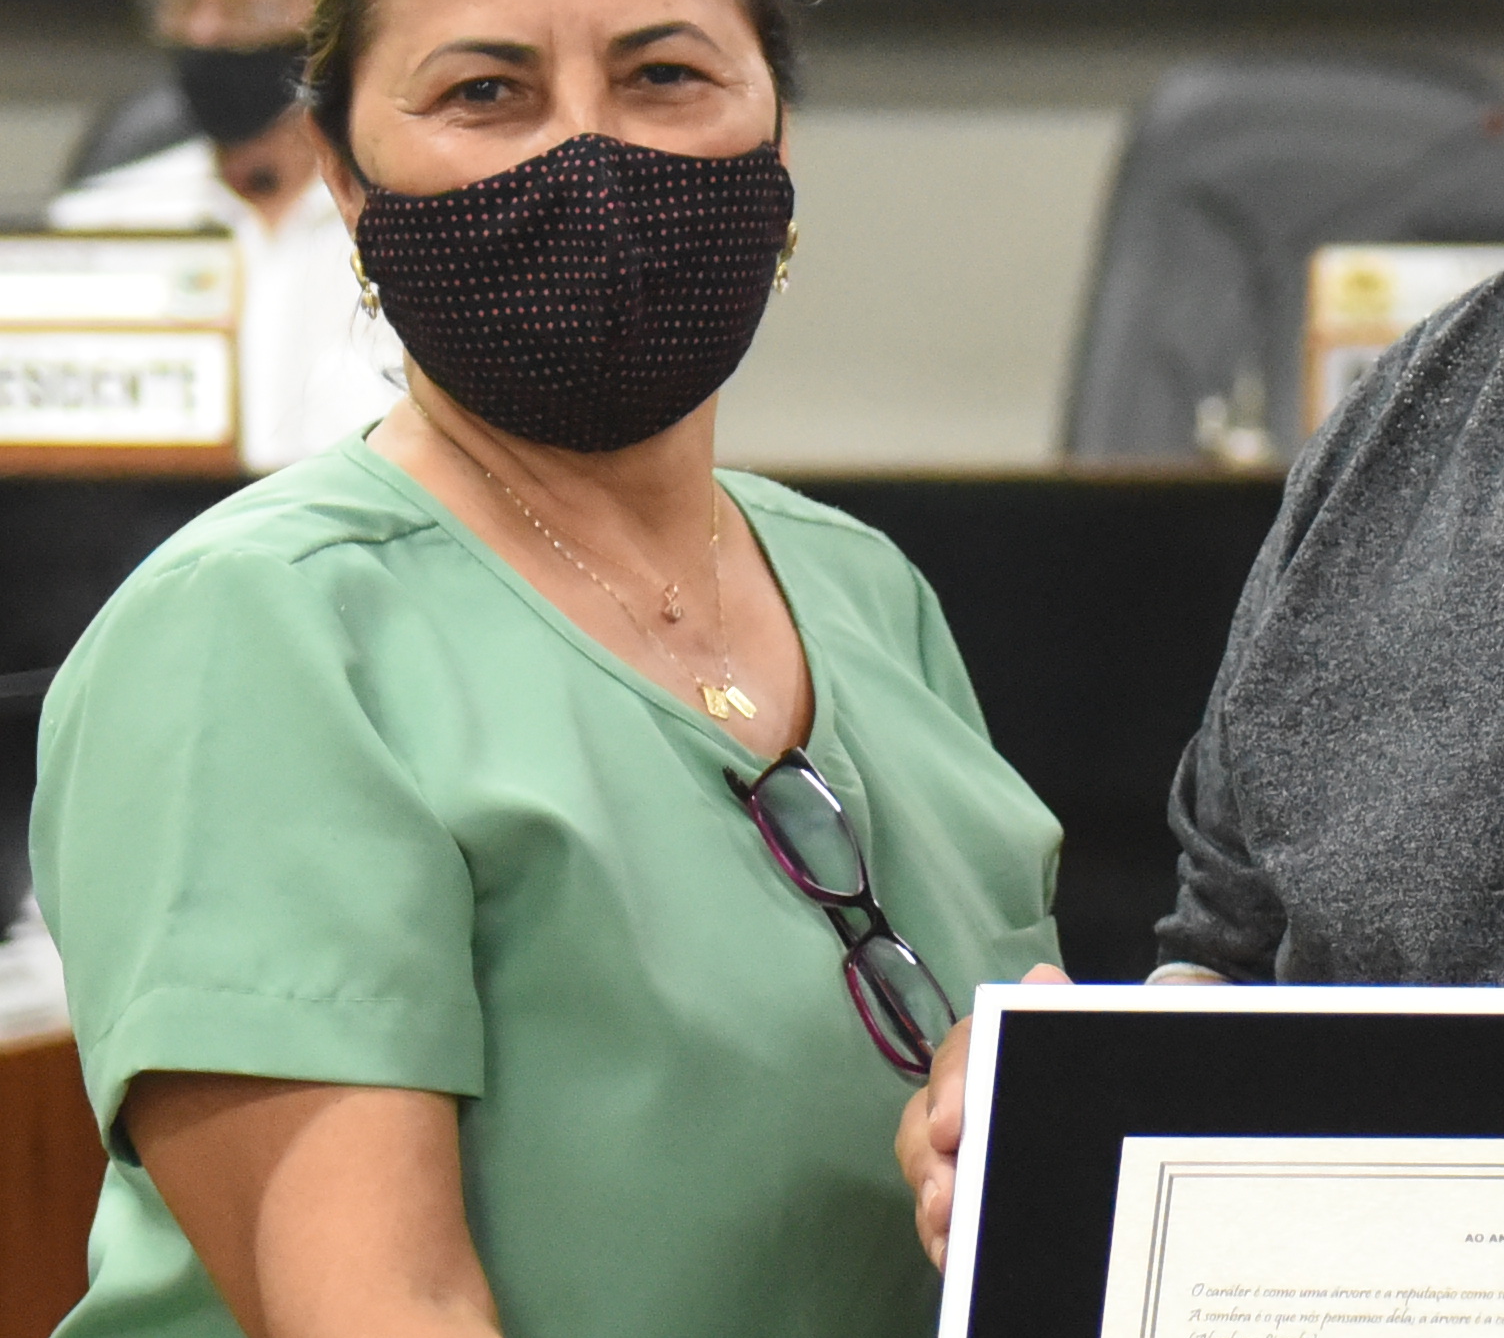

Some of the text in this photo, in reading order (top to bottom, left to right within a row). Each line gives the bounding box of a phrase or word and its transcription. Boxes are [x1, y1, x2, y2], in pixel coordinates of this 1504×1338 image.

[1464, 1233, 1485, 1243] AO
[1190, 1282, 1206, 1297] O
[1261, 1288, 1297, 1299] como
[1298, 1288, 1329, 1299] uma
[1459, 1290, 1495, 1300] como
[1187, 1307, 1202, 1323] A
[1202, 1306, 1252, 1323] sombra
[1273, 1313, 1297, 1331] que
[1319, 1311, 1384, 1331] pensamos
